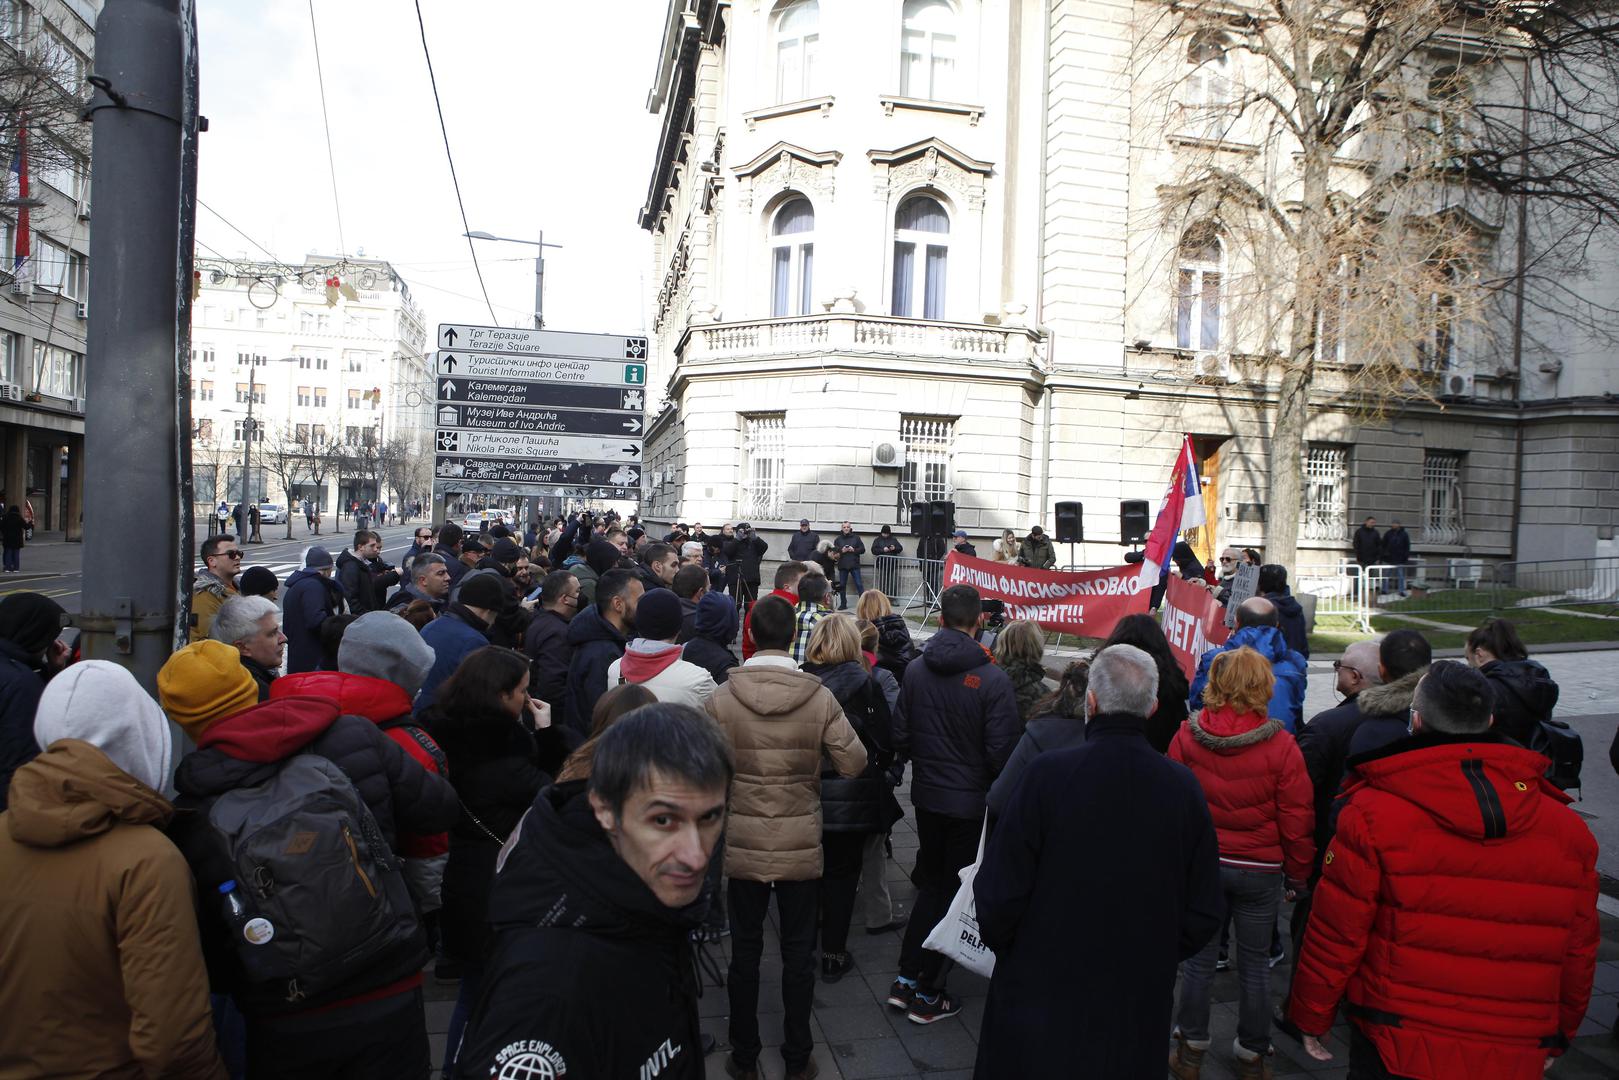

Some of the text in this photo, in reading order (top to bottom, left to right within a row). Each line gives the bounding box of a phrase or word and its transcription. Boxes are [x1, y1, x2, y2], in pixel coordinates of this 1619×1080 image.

[469, 328, 530, 342] Трг Теразије
[469, 339, 540, 352] Terazije Square
[527, 359, 552, 370] инфо
[468, 365, 586, 380] Tourist Information Centre
[468, 381, 528, 393] Калемегдан
[467, 391, 526, 403] Kalemegdan
[466, 407, 558, 420] Музеј Иве Андрића
[466, 418, 566, 431] Museum of Ivo Andric
[466, 433, 560, 446] Трг Николе Пашића
[466, 443, 559, 457] Nikola Pasic Square
[465, 459, 504, 469] Савезна
[464, 469, 552, 481] Federal Parliament
[950, 563, 1141, 598] ДРАГИША ФАЛСИФИКОВАО
[495, 1039, 528, 1065] SPACE
